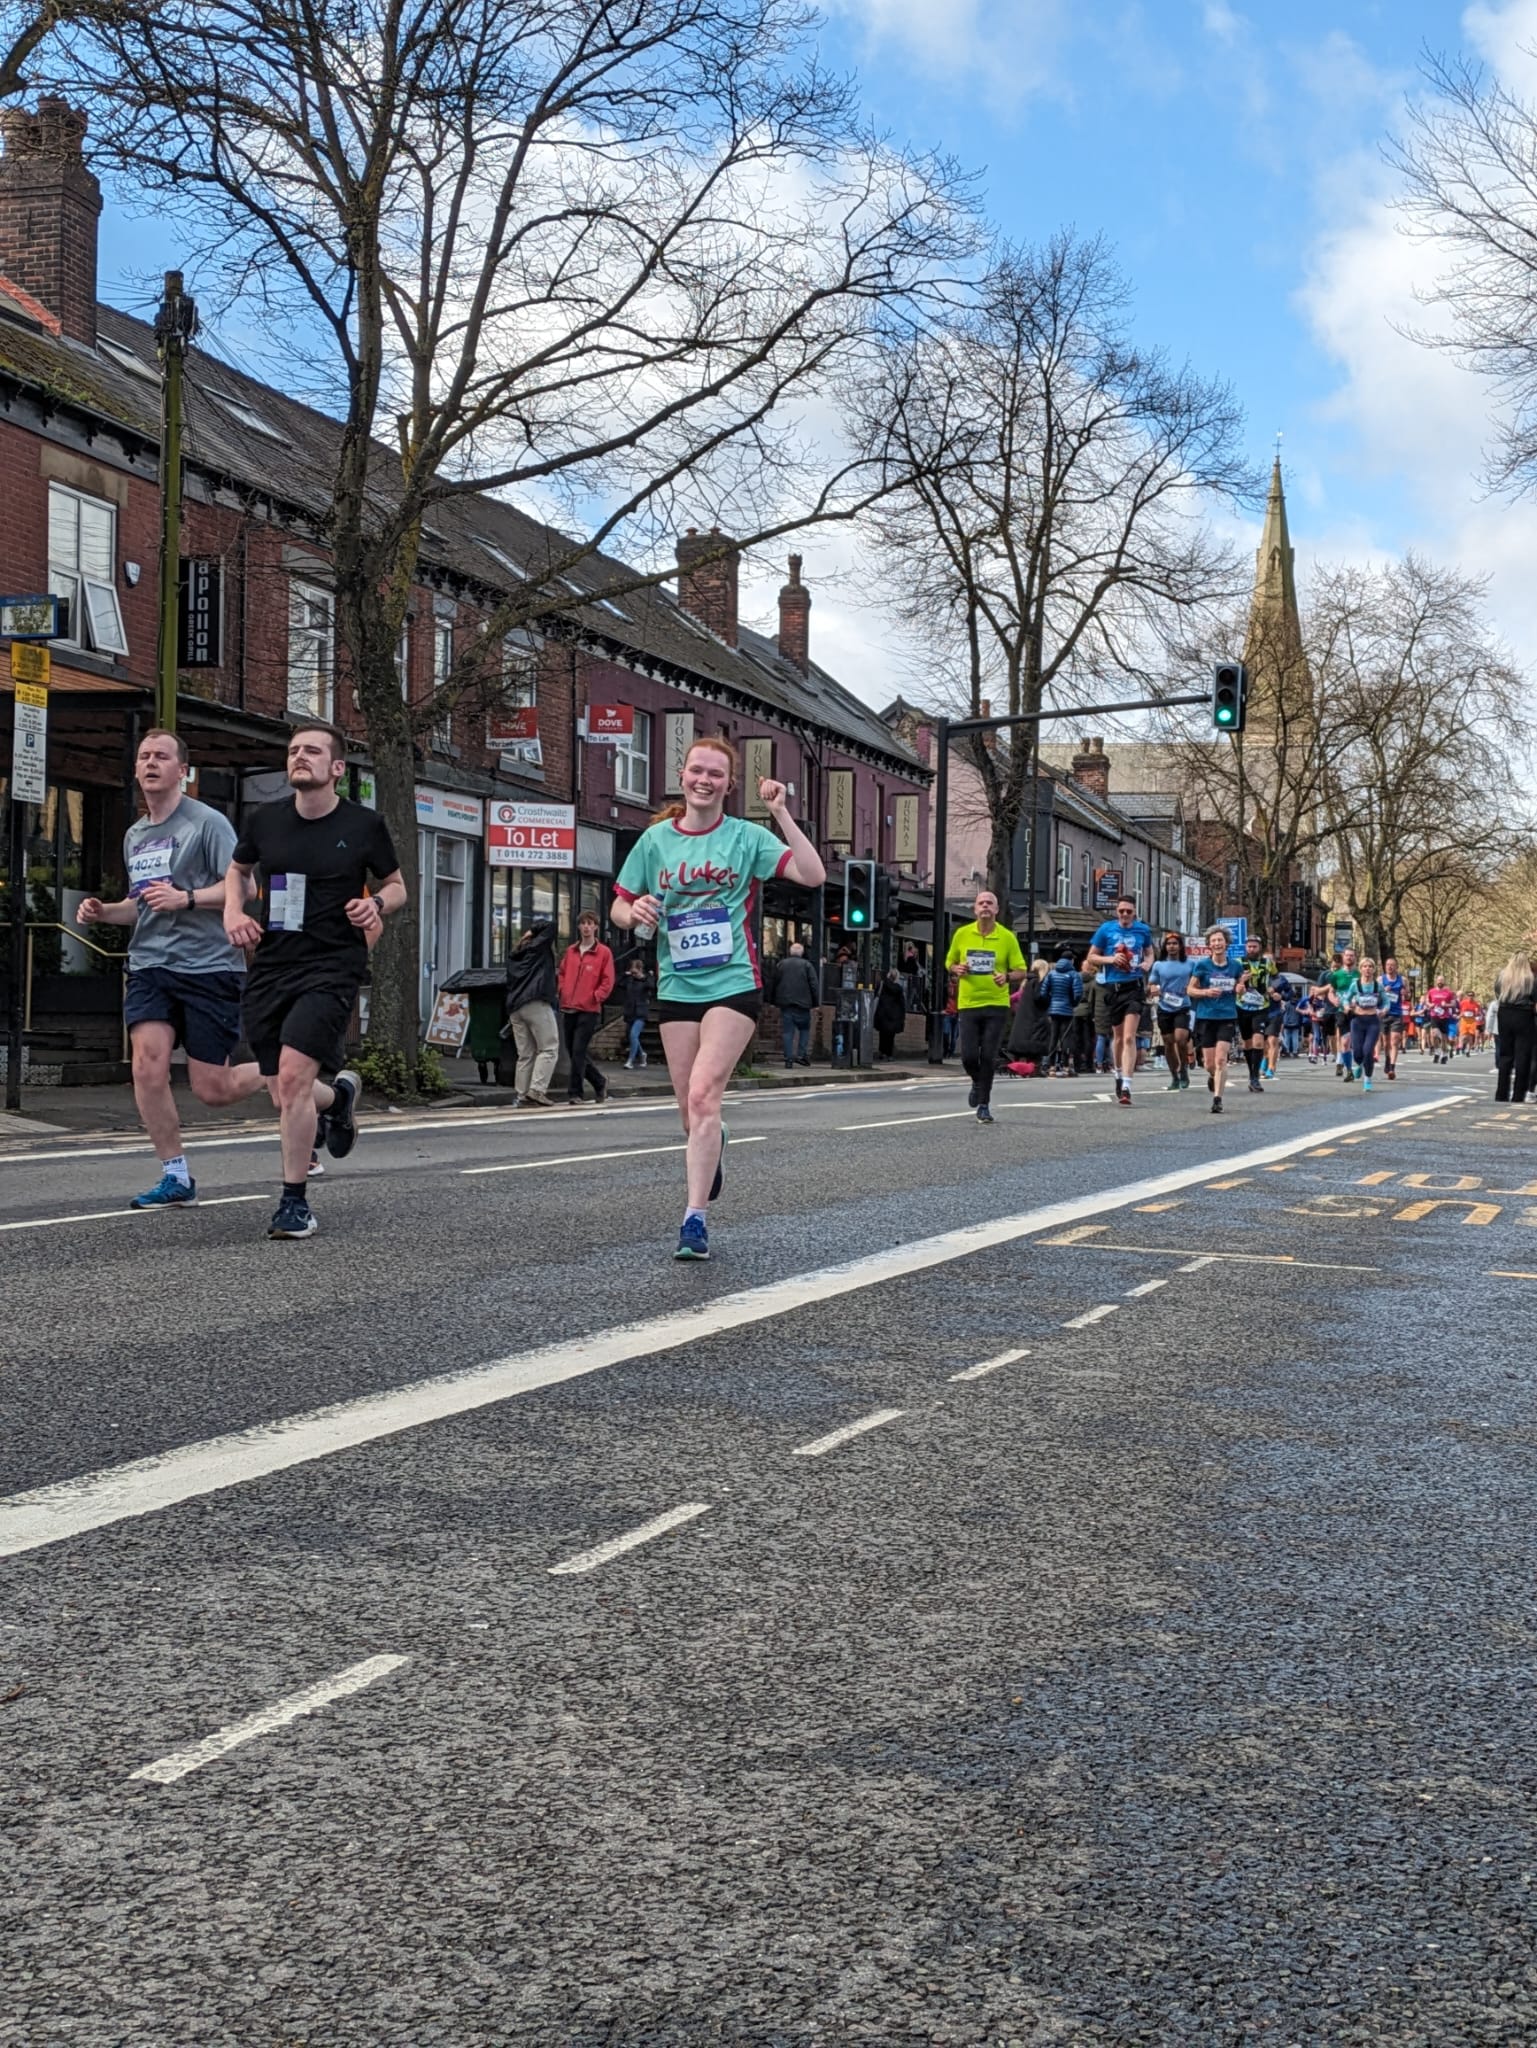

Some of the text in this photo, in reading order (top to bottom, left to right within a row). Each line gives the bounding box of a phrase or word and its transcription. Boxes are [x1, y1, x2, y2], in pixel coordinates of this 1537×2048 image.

[196, 561, 209, 661] apollon
[598, 719, 623, 727] DOVE
[517, 806, 568, 817] Crosthwaite
[517, 816, 566, 825] COMMERCIAL
[504, 827, 559, 847] To Let
[497, 849, 502, 857] T
[504, 849, 525, 858] 0114
[528, 850, 543, 859] 272
[678, 860, 740, 889] Luke's
[681, 931, 721, 949] 6258
